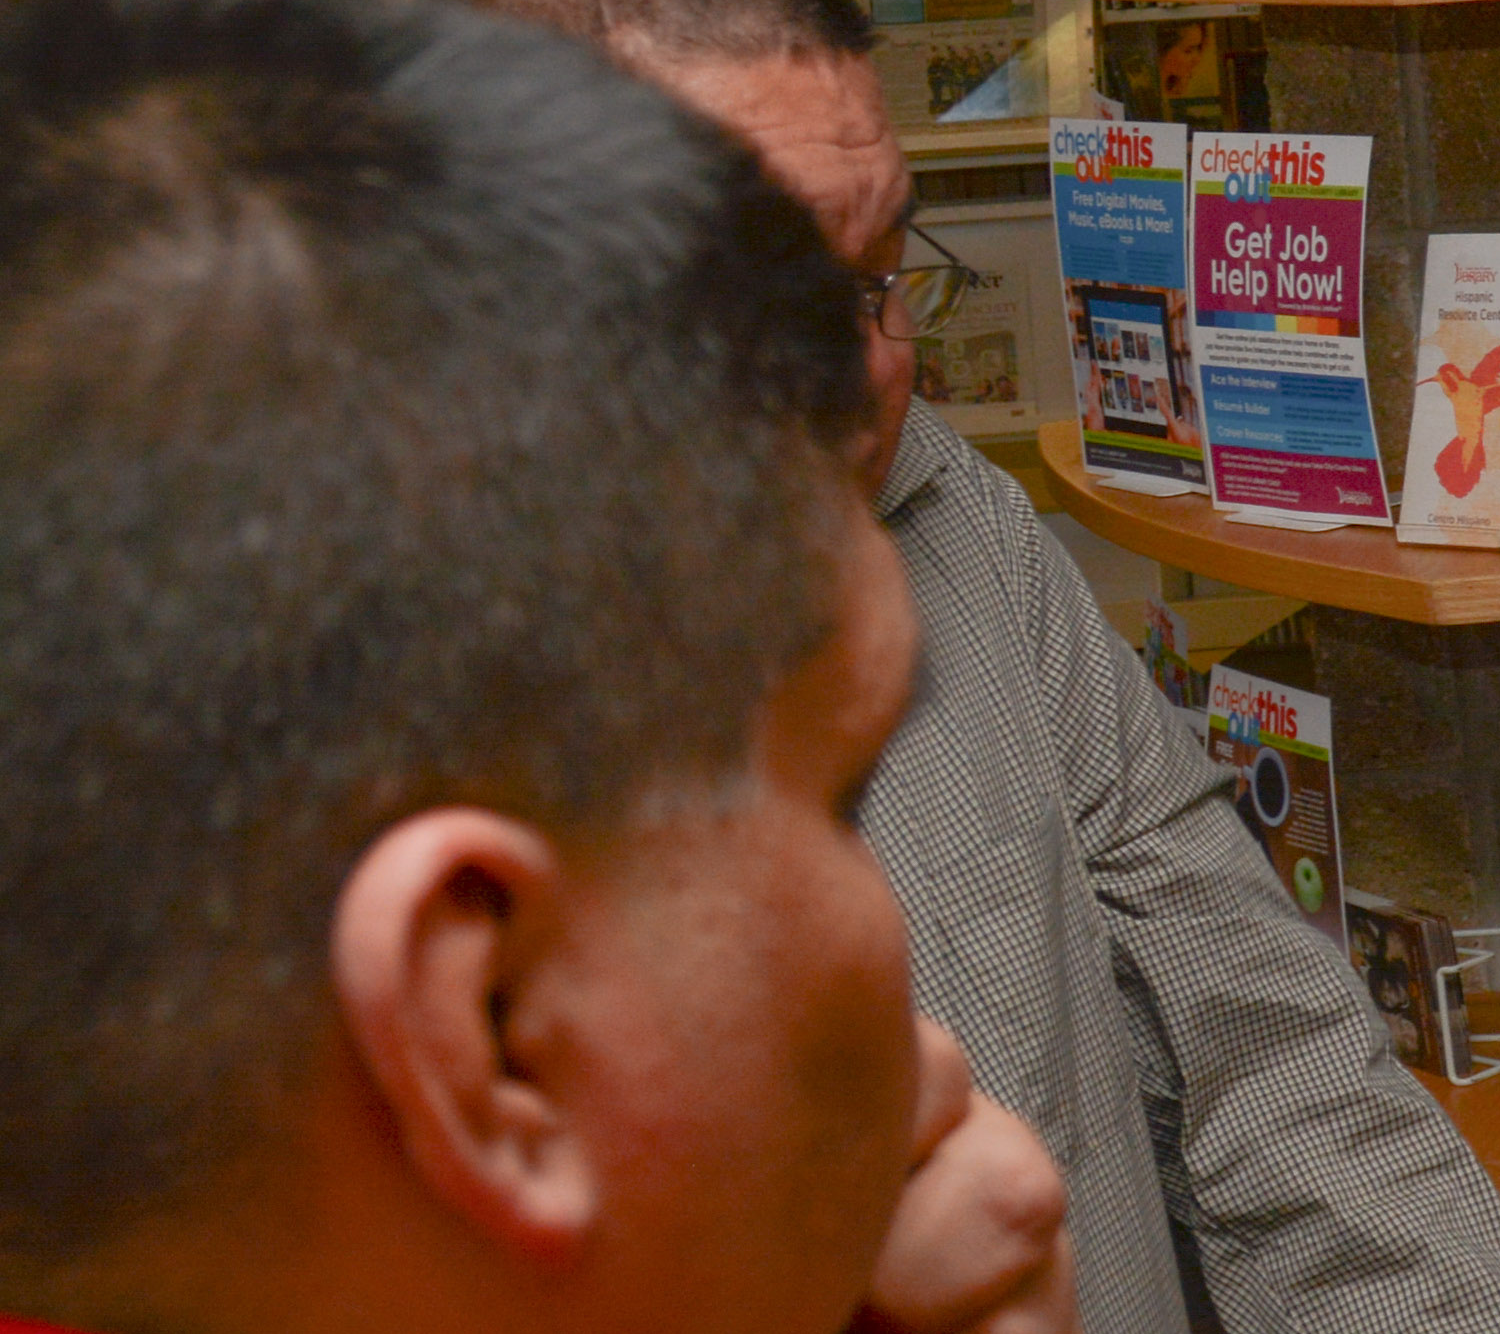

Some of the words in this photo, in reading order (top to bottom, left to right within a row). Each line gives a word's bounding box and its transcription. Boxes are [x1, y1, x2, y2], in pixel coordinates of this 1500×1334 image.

[1054, 124, 1107, 156] check
[1106, 126, 1154, 169] this
[1075, 154, 1114, 185] out
[1200, 139, 1269, 173] check
[1268, 141, 1326, 186] this
[1224, 167, 1272, 203] out
[1072, 189, 1094, 207] Free
[1095, 192, 1127, 212] Digital
[1129, 194, 1166, 214] Movies,
[1068, 210, 1097, 230] Music,
[1098, 213, 1134, 231] eBooks
[1135, 216, 1143, 231] &
[1145, 216, 1174, 234] More!
[1225, 221, 1273, 260] Get
[1279, 224, 1328, 263] Job
[1211, 259, 1268, 305] Help
[1277, 263, 1343, 303] Now!
[1455, 291, 1494, 305] Hispanic
[1438, 308, 1477, 322] Resource
[1211, 373, 1227, 385] Ace
[1227, 373, 1240, 387] the
[1241, 376, 1278, 390] Interview
[1245, 402, 1271, 415] Builder
[1216, 425, 1243, 439] Career
[1244, 428, 1284, 443] Resources
[1427, 513, 1455, 524] Centro
[1456, 515, 1491, 527] Hispano
[1213, 673, 1258, 716] check
[1257, 690, 1298, 740] this
[1228, 712, 1262, 747] out
[1215, 740, 1235, 758] FREE
